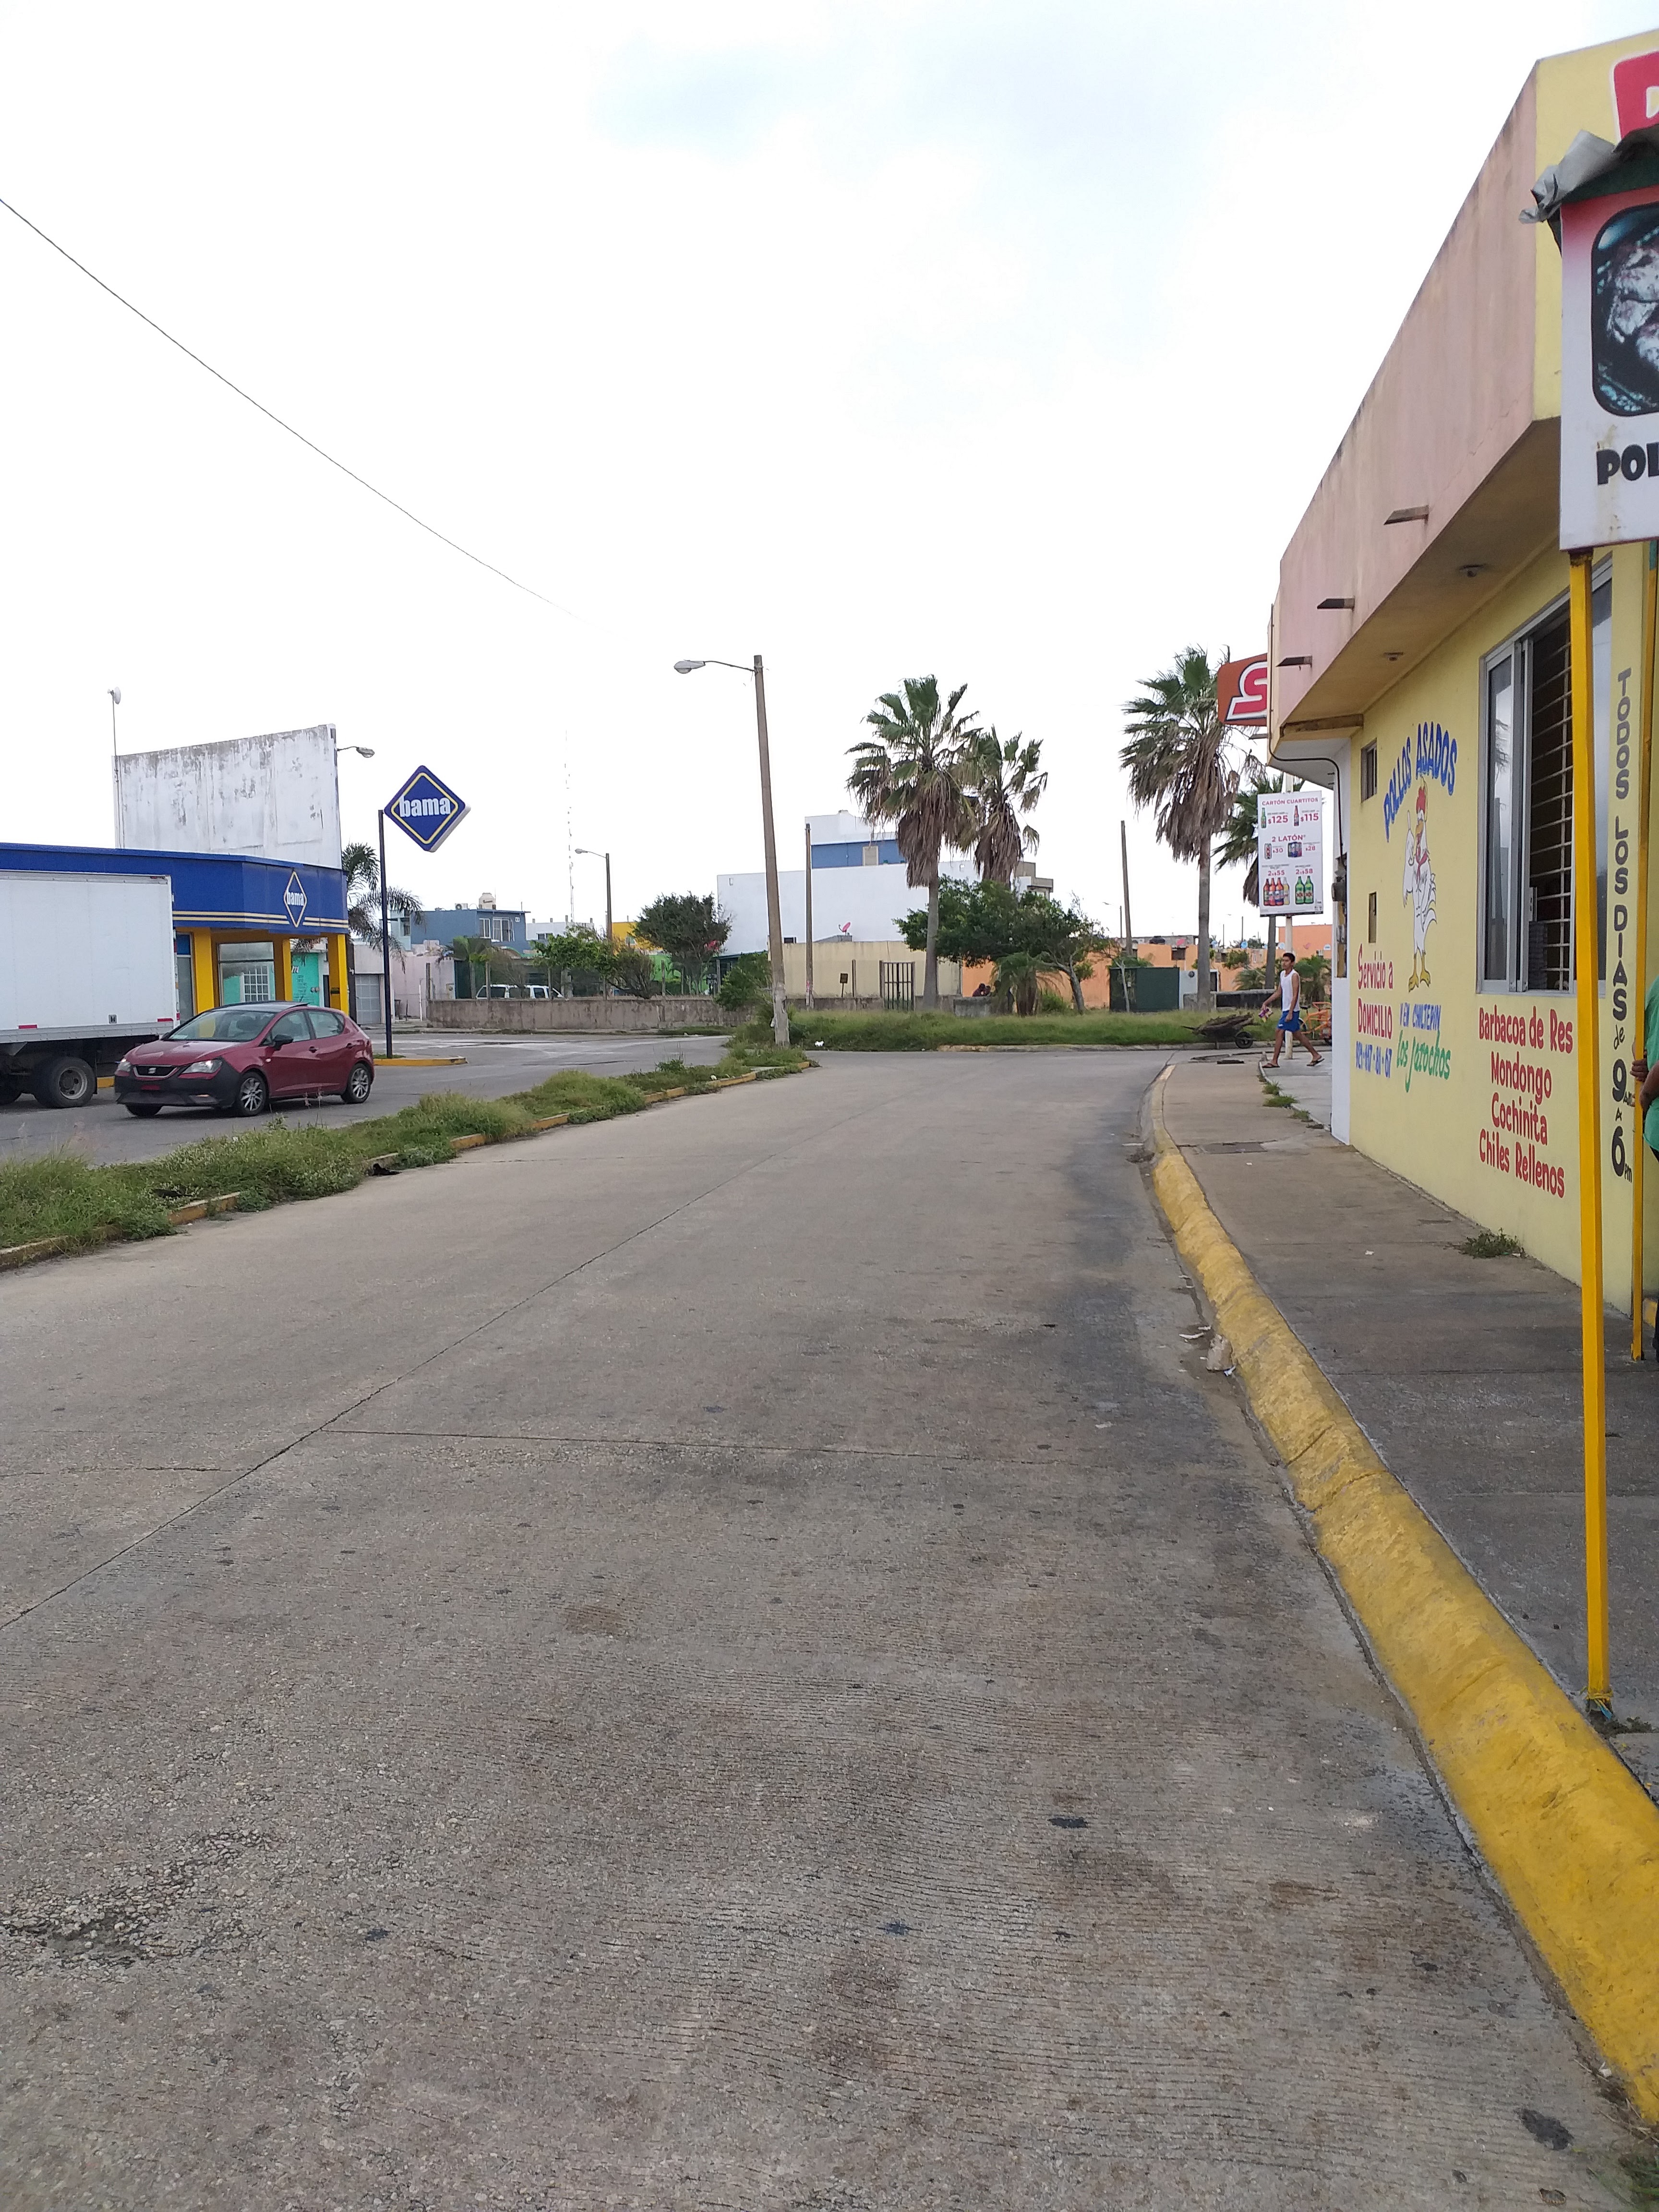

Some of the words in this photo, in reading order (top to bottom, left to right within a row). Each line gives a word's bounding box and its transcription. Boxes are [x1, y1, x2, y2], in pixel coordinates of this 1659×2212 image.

[1615, 668, 1632, 799] TODOS
[399, 794, 451, 817] bama
[1383, 736, 1411, 843] POLLOS
[1416, 721, 1457, 795] ASADOS
[1268, 815, 1288, 824] $125
[1300, 813, 1319, 822] $115
[1614, 816, 1629, 894] LOS
[287, 888, 304, 906] bama
[1358, 943, 1386, 990] Servicio
[1389, 961, 1393, 989] a
[1613, 904, 1627, 1021] DIAS
[1479, 1004, 1526, 1047] Barbacoa
[1529, 1006, 1544, 1049] de
[1550, 1009, 1573, 1054] Res
[1613, 1024, 1625, 1050] de
[1491, 1051, 1552, 1105] Mondongo
[1491, 1092, 1548, 1145] Cochinita
[1479, 1129, 1509, 1173] Chiles
[1515, 1142, 1564, 1198] Rellenos
